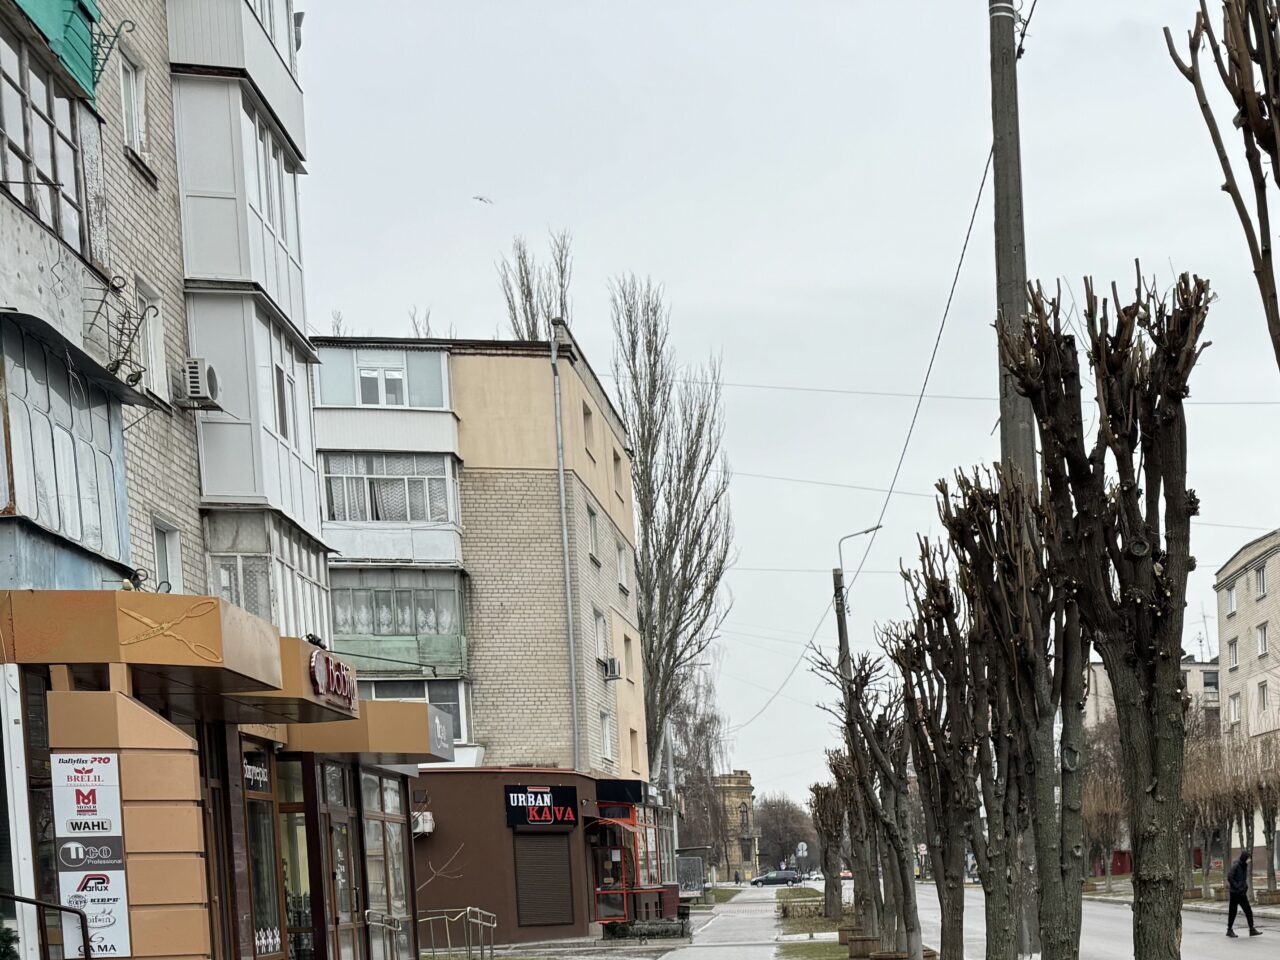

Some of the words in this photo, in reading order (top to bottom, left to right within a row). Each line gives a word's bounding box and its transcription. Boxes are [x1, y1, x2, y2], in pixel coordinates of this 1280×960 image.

[90, 756, 111, 764] PRO
[509, 793, 551, 806] URBAN
[528, 806, 576, 820] KAVA
[70, 821, 108, 831] WAHL
[76, 873, 111, 892] Parlux
